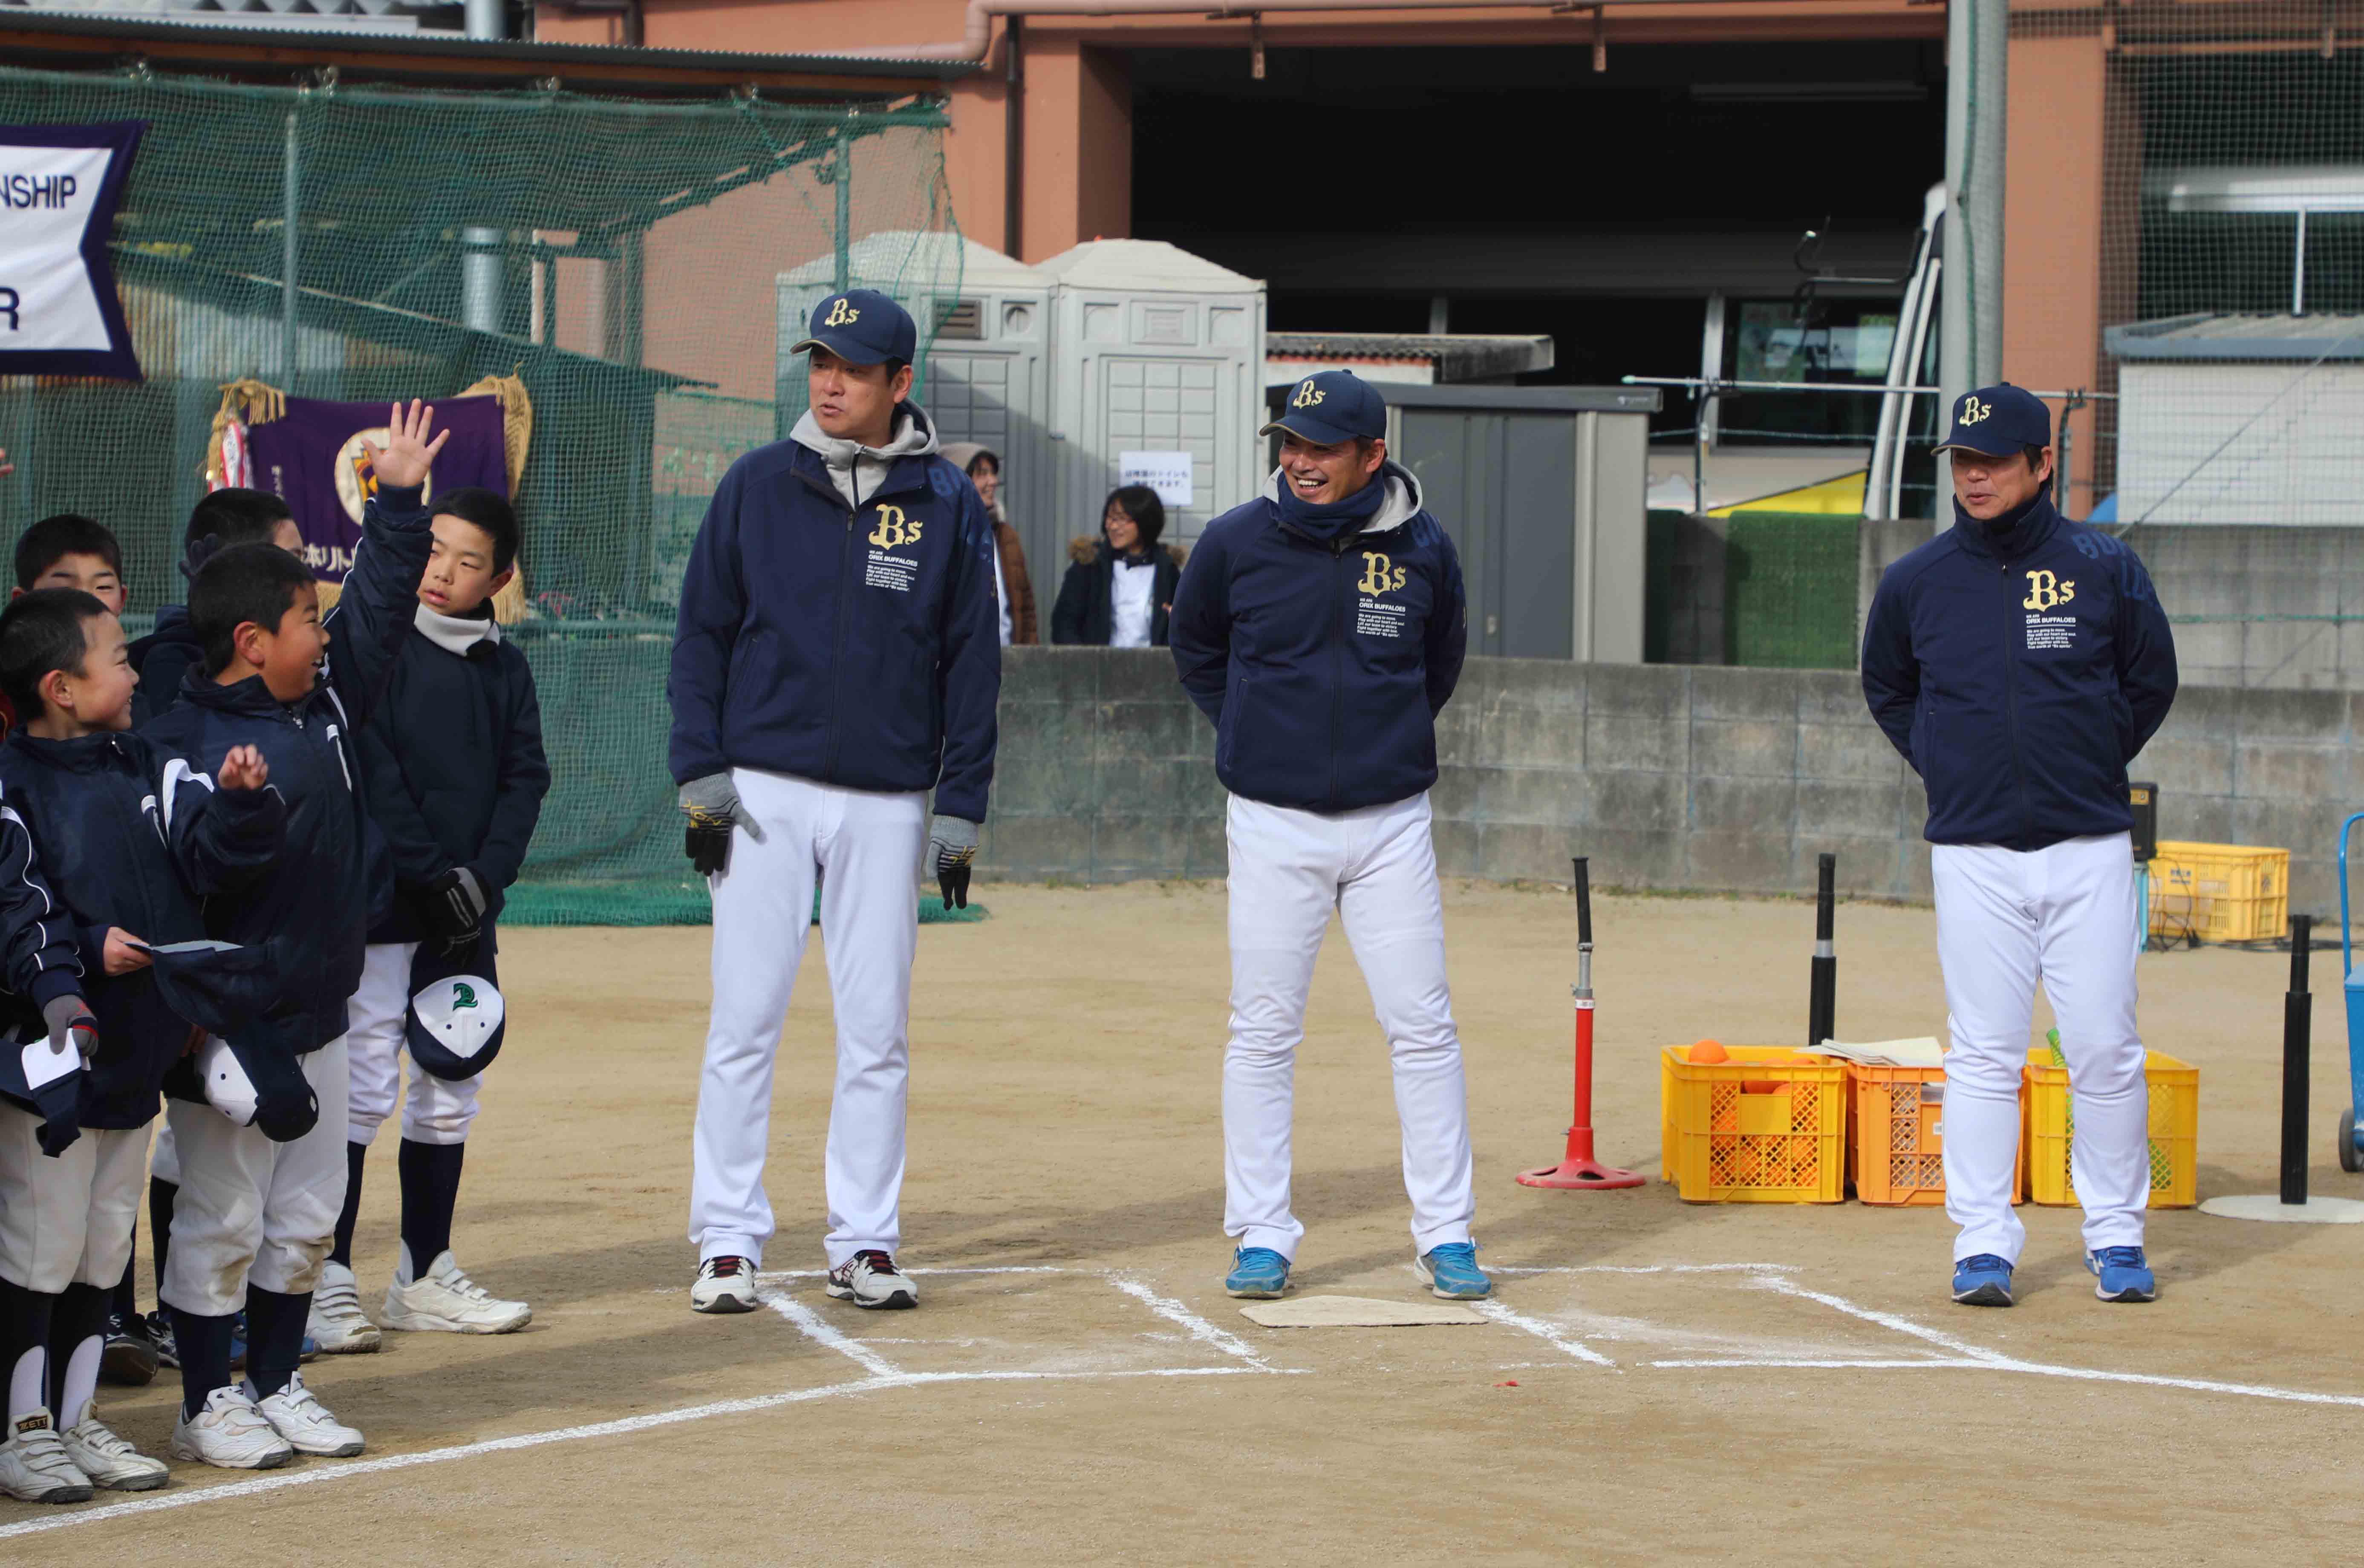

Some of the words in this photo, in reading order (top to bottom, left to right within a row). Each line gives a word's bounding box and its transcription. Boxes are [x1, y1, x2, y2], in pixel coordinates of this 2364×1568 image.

[868, 503, 923, 551] Bs
[884, 556, 918, 567] BUFFALOES
[1357, 551, 1406, 598] Bs
[1374, 603, 1406, 612] BUFFALOES
[2023, 570, 2075, 612] Bs
